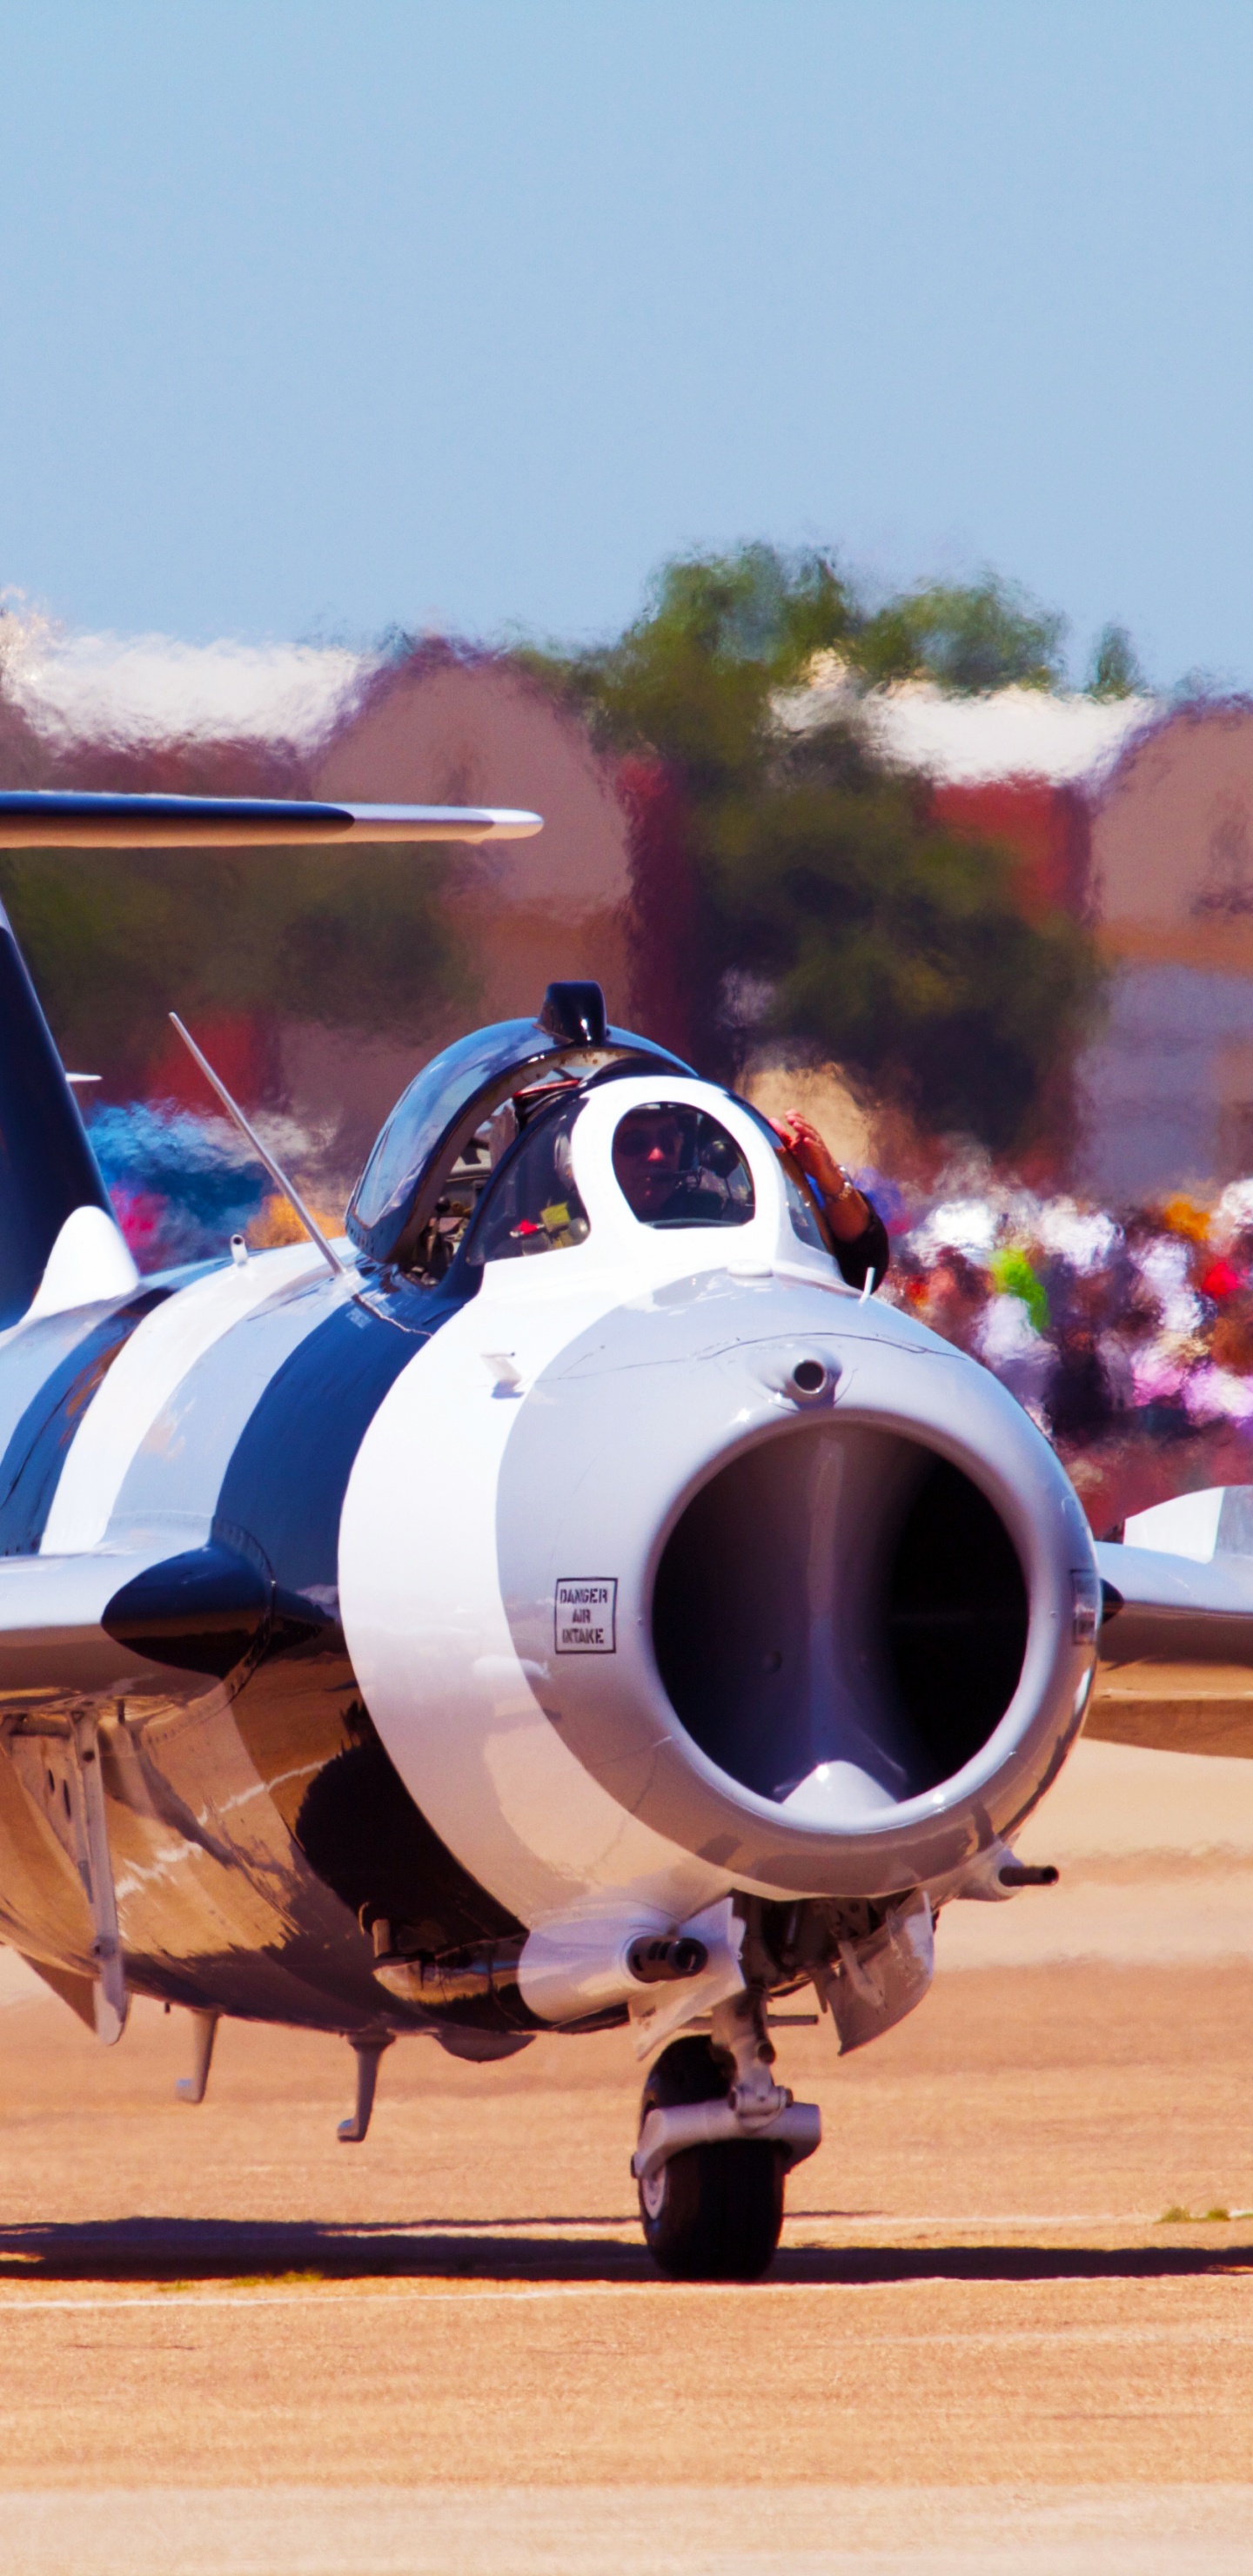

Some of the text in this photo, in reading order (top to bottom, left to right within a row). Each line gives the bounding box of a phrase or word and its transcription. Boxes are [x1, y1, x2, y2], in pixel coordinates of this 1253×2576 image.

[559, 1588, 607, 1604] DANGER
[572, 1608, 591, 1624] AIR
[562, 1628, 604, 1644] INTAKE
